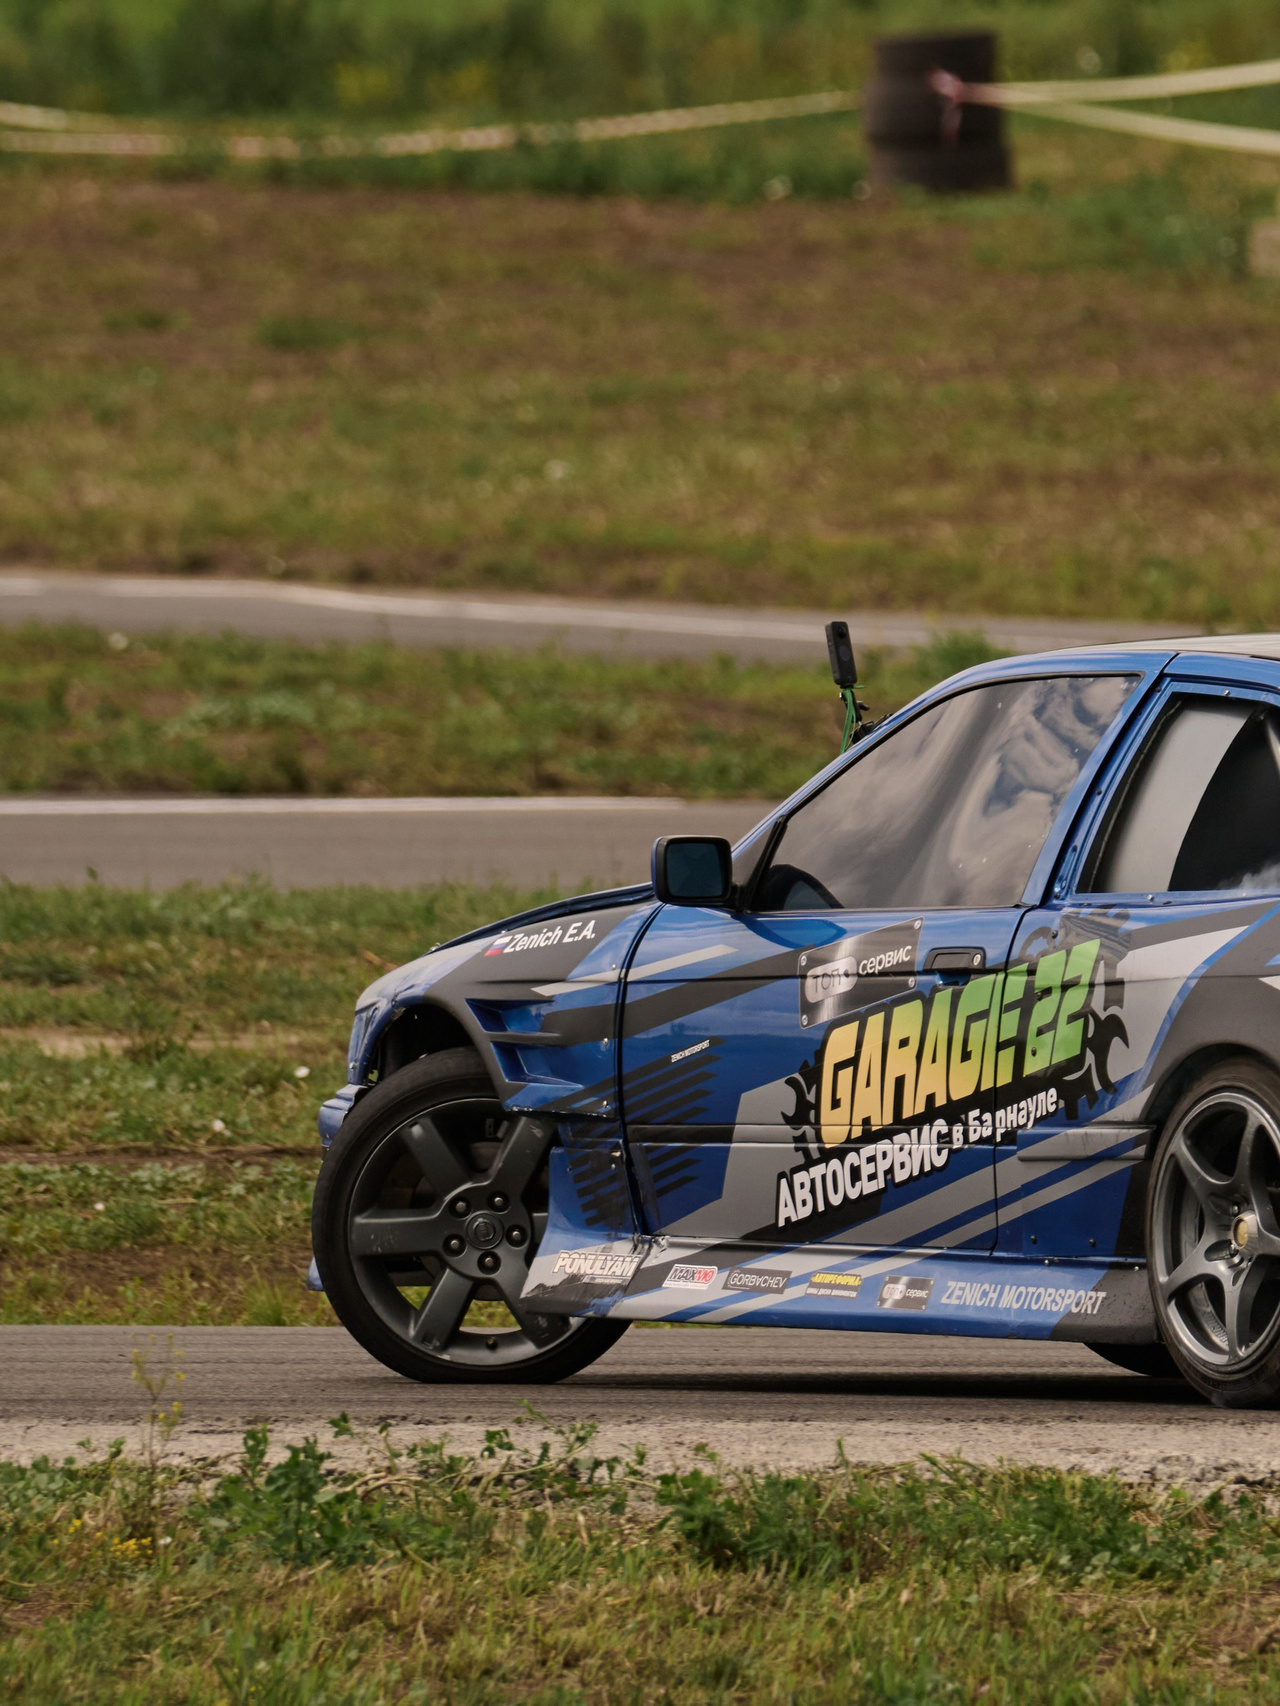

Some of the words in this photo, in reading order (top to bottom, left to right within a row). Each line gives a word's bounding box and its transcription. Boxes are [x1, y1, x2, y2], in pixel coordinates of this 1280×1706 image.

[503, 925, 562, 954] Zenich
[562, 920, 596, 944] E.A.
[859, 945, 912, 976] сервис
[819, 962, 1030, 1148] GARAGE
[1023, 938, 1101, 1077] 22
[777, 1118, 949, 1228] АВТОСЕРВИС
[952, 1122, 964, 1149] в
[968, 1087, 1058, 1143] Барнауле
[552, 1251, 641, 1277] PONULYAM
[941, 1280, 999, 1308] ZENICH
[998, 1285, 1107, 1315] MOTORSPORT
